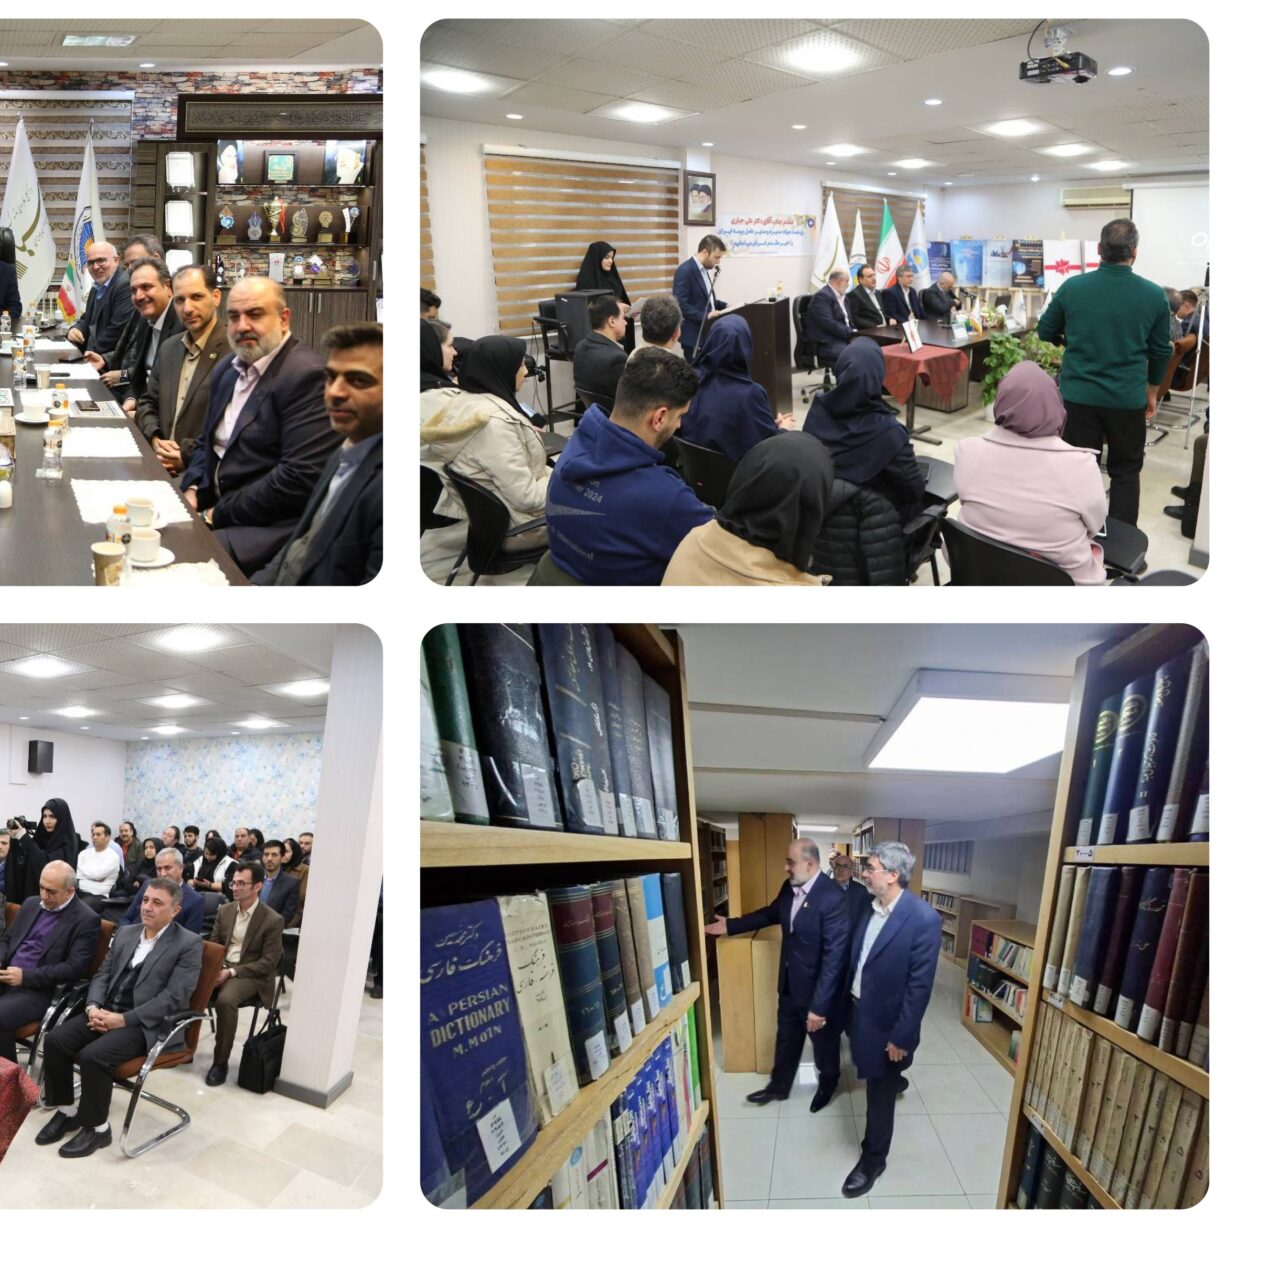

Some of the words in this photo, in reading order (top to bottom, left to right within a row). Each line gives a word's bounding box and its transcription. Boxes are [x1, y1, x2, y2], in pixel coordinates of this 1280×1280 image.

[428, 1012, 439, 1024] A
[448, 983, 509, 1016] PERSIAN
[430, 997, 511, 1048] DICTIONARY
